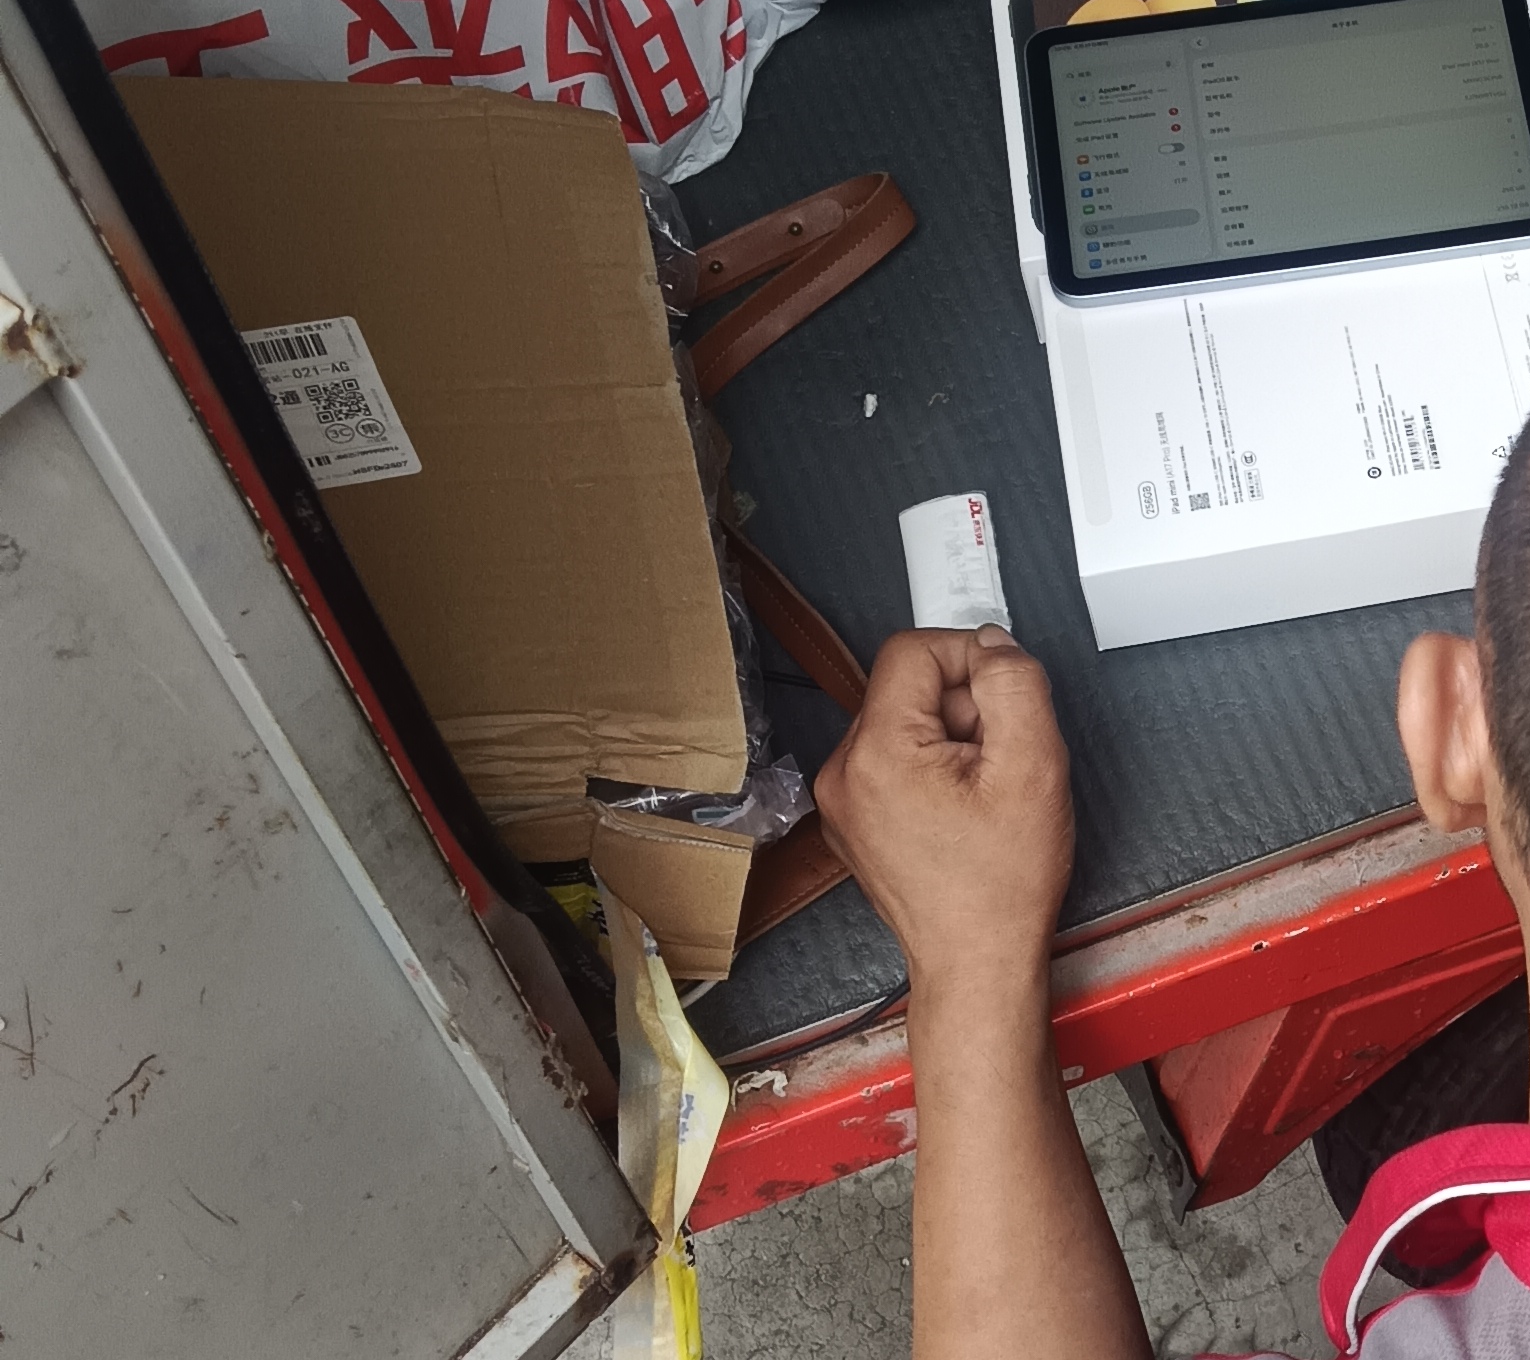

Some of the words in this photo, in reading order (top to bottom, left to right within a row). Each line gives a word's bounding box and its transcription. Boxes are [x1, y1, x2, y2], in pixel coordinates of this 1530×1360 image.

[1166, 480, 1178, 496] mini
[968, 497, 984, 519] JDL
[1142, 484, 1156, 515] 256GB
[1169, 498, 1181, 515] iPad
